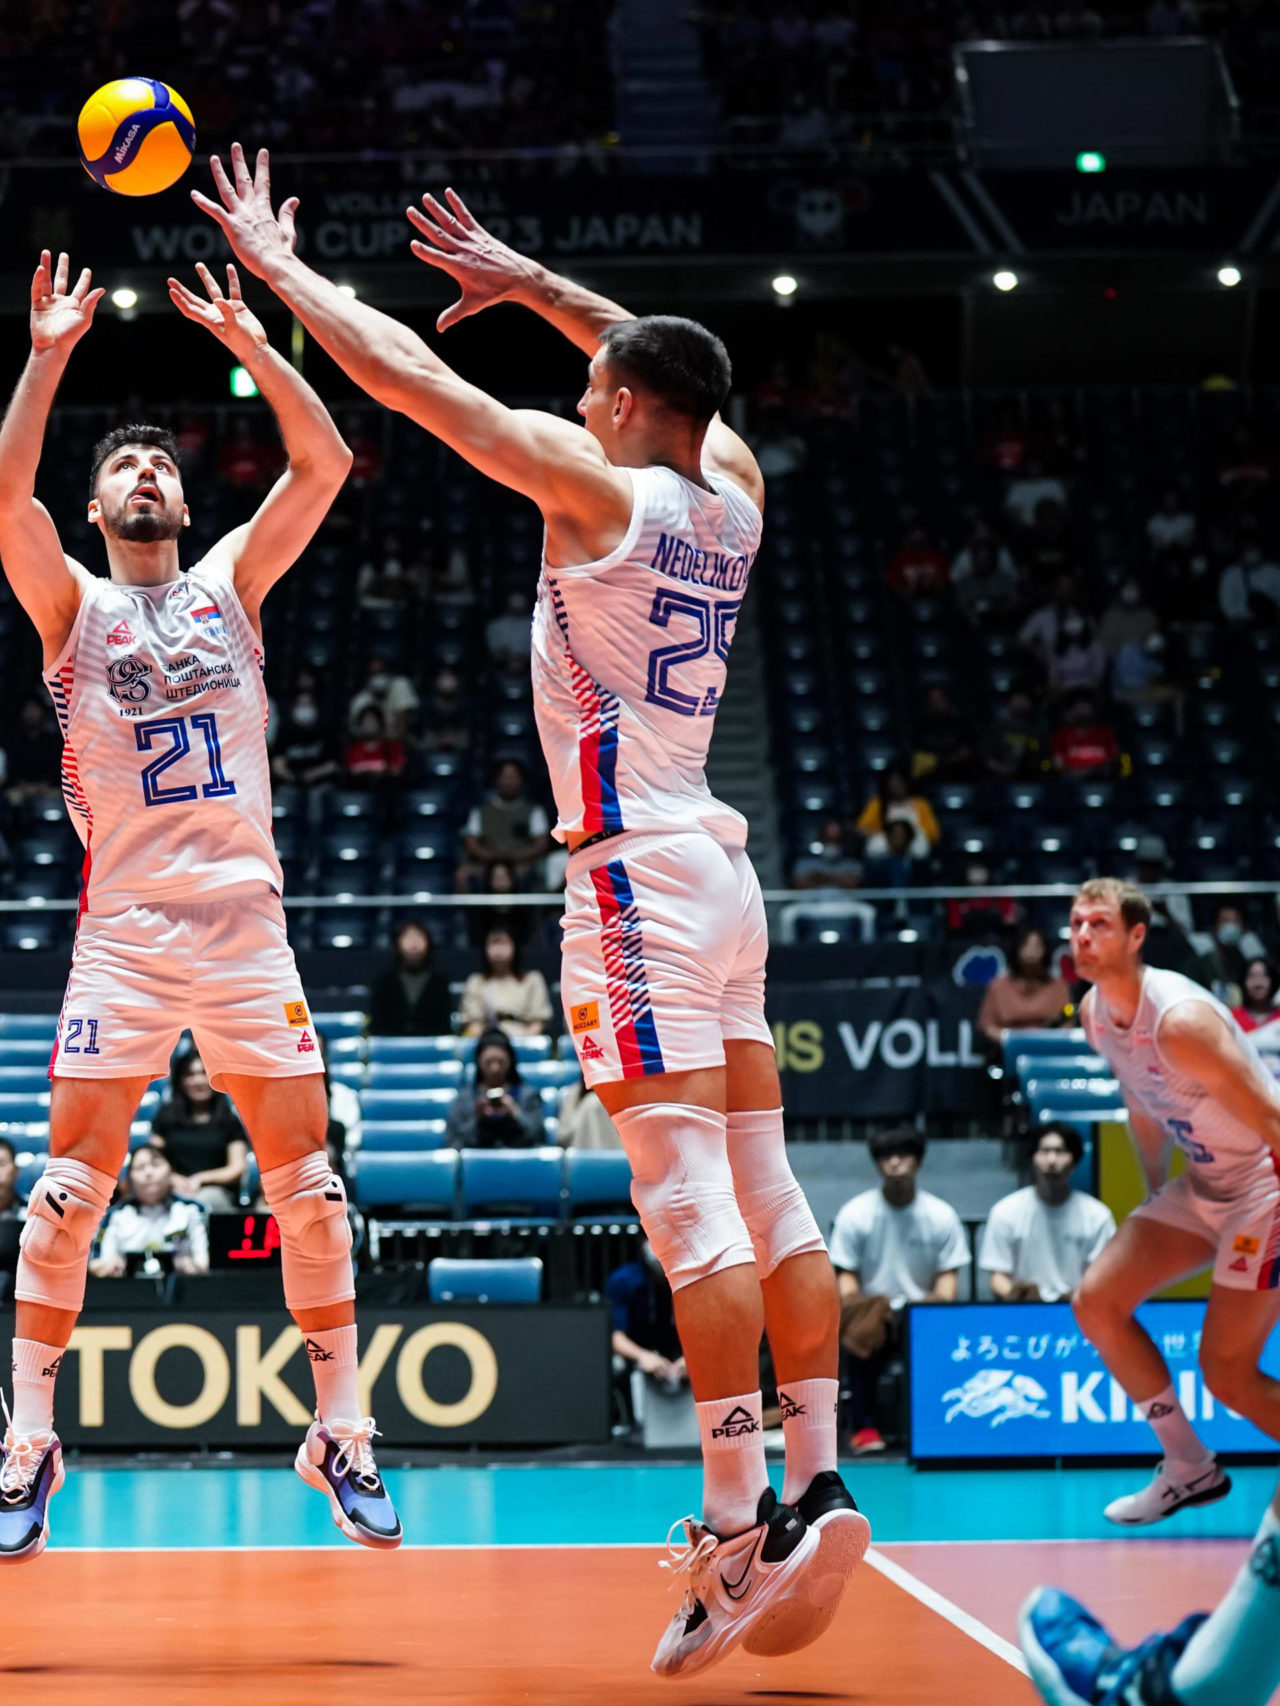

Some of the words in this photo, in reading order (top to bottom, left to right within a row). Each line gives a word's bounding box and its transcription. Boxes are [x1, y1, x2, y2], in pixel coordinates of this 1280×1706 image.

[1054, 188, 1208, 227] JAPAN
[315, 221, 407, 258] CUP
[552, 211, 704, 252] JAPAN
[106, 634, 136, 646] PEAK
[164, 663, 234, 685] ПОШТАНСКА
[166, 677, 242, 699] ШТЕДИОНИЦА
[120, 706, 143, 717] 1921
[133, 712, 237, 808] 21
[64, 1018, 100, 1055] 21
[837, 1017, 986, 1070] VOLL
[308, 1351, 335, 1361] EAK
[781, 1404, 807, 1421] EAK
[712, 1420, 760, 1439] PEAK
